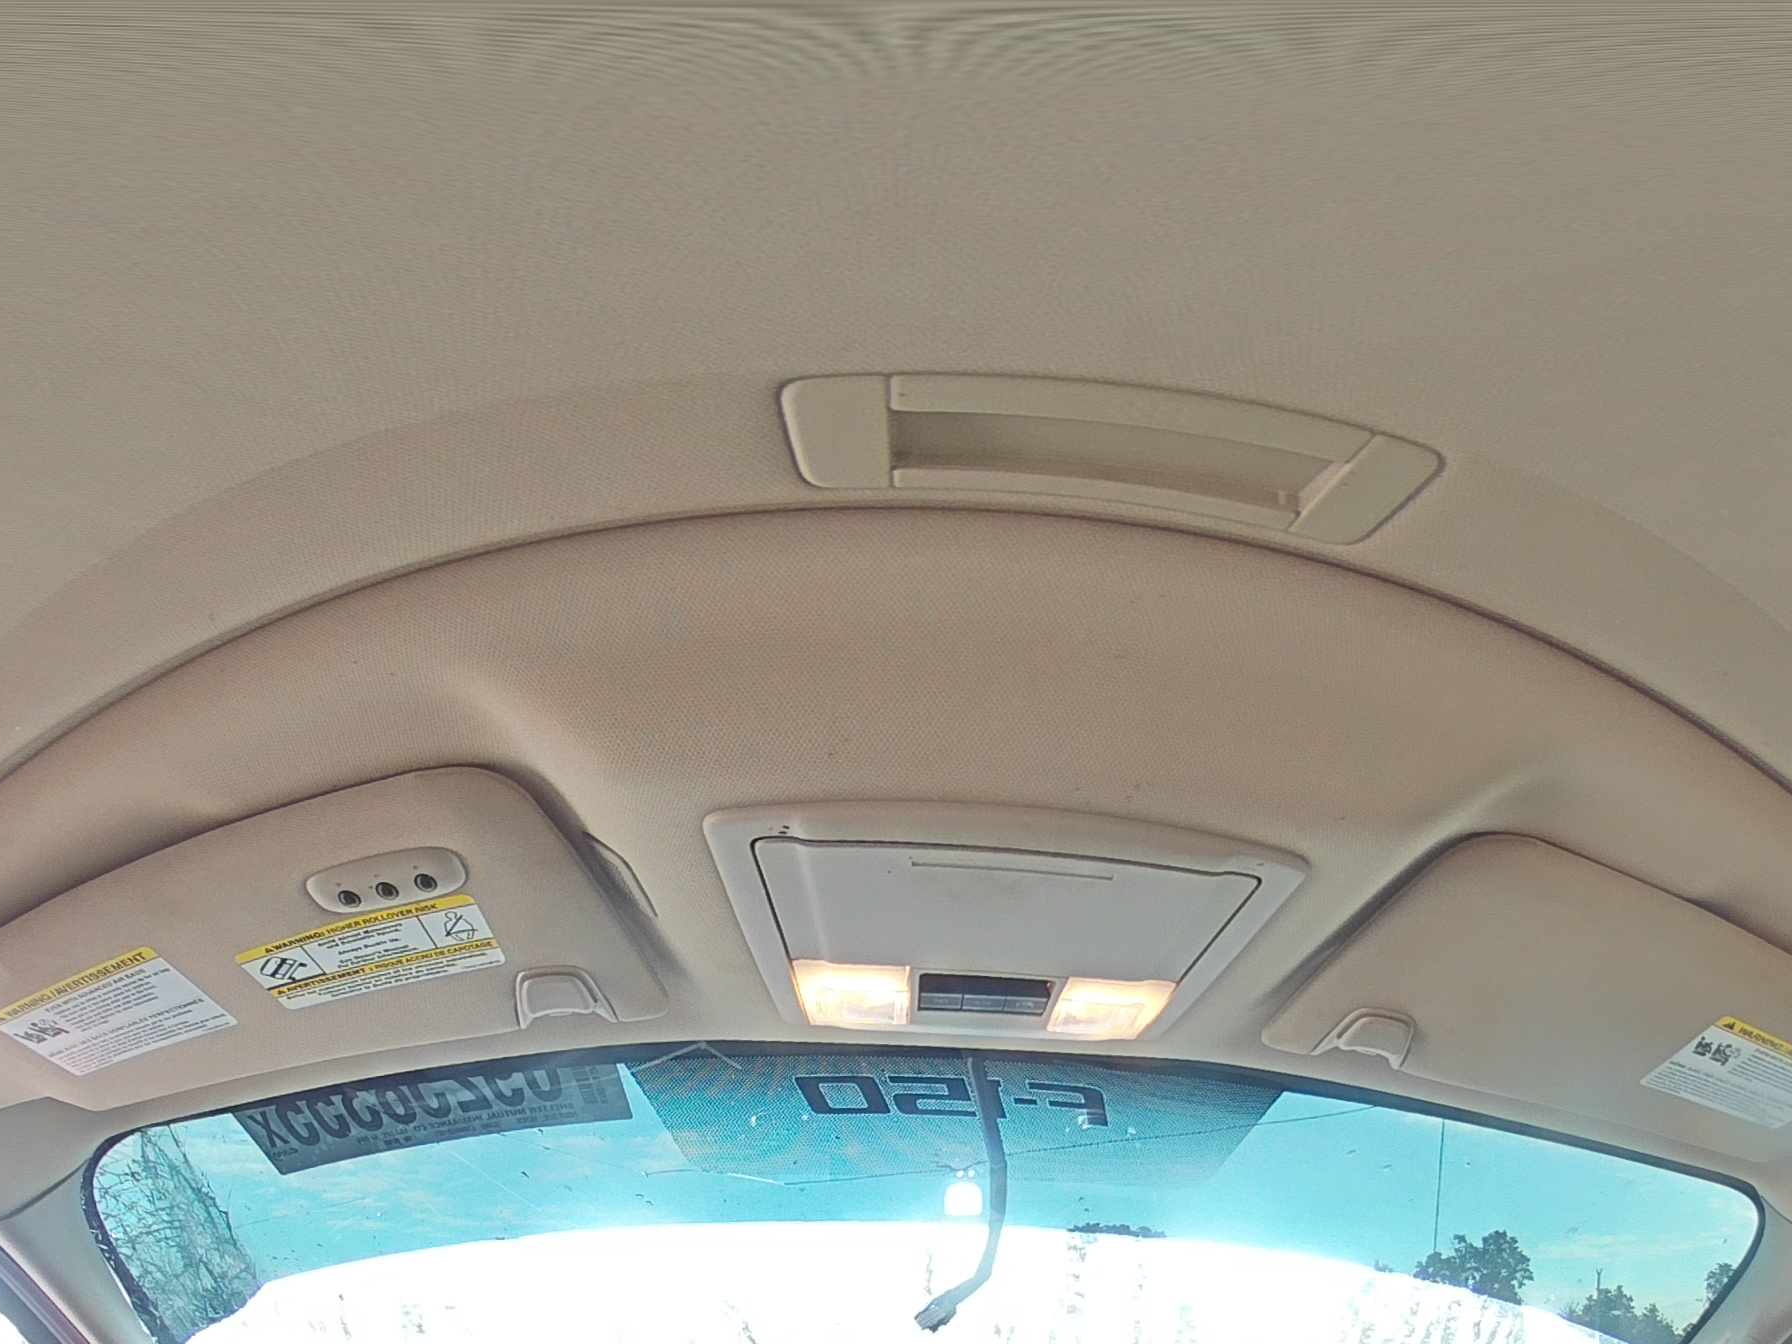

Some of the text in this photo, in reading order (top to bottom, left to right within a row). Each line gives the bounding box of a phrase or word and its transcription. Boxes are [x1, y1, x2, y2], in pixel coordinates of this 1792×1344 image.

[327, 920, 360, 934] HIGHER
[361, 909, 413, 928] ROLLOVER
[415, 903, 438, 916] RISK
[286, 967, 366, 992] AVERTISSEMENT
